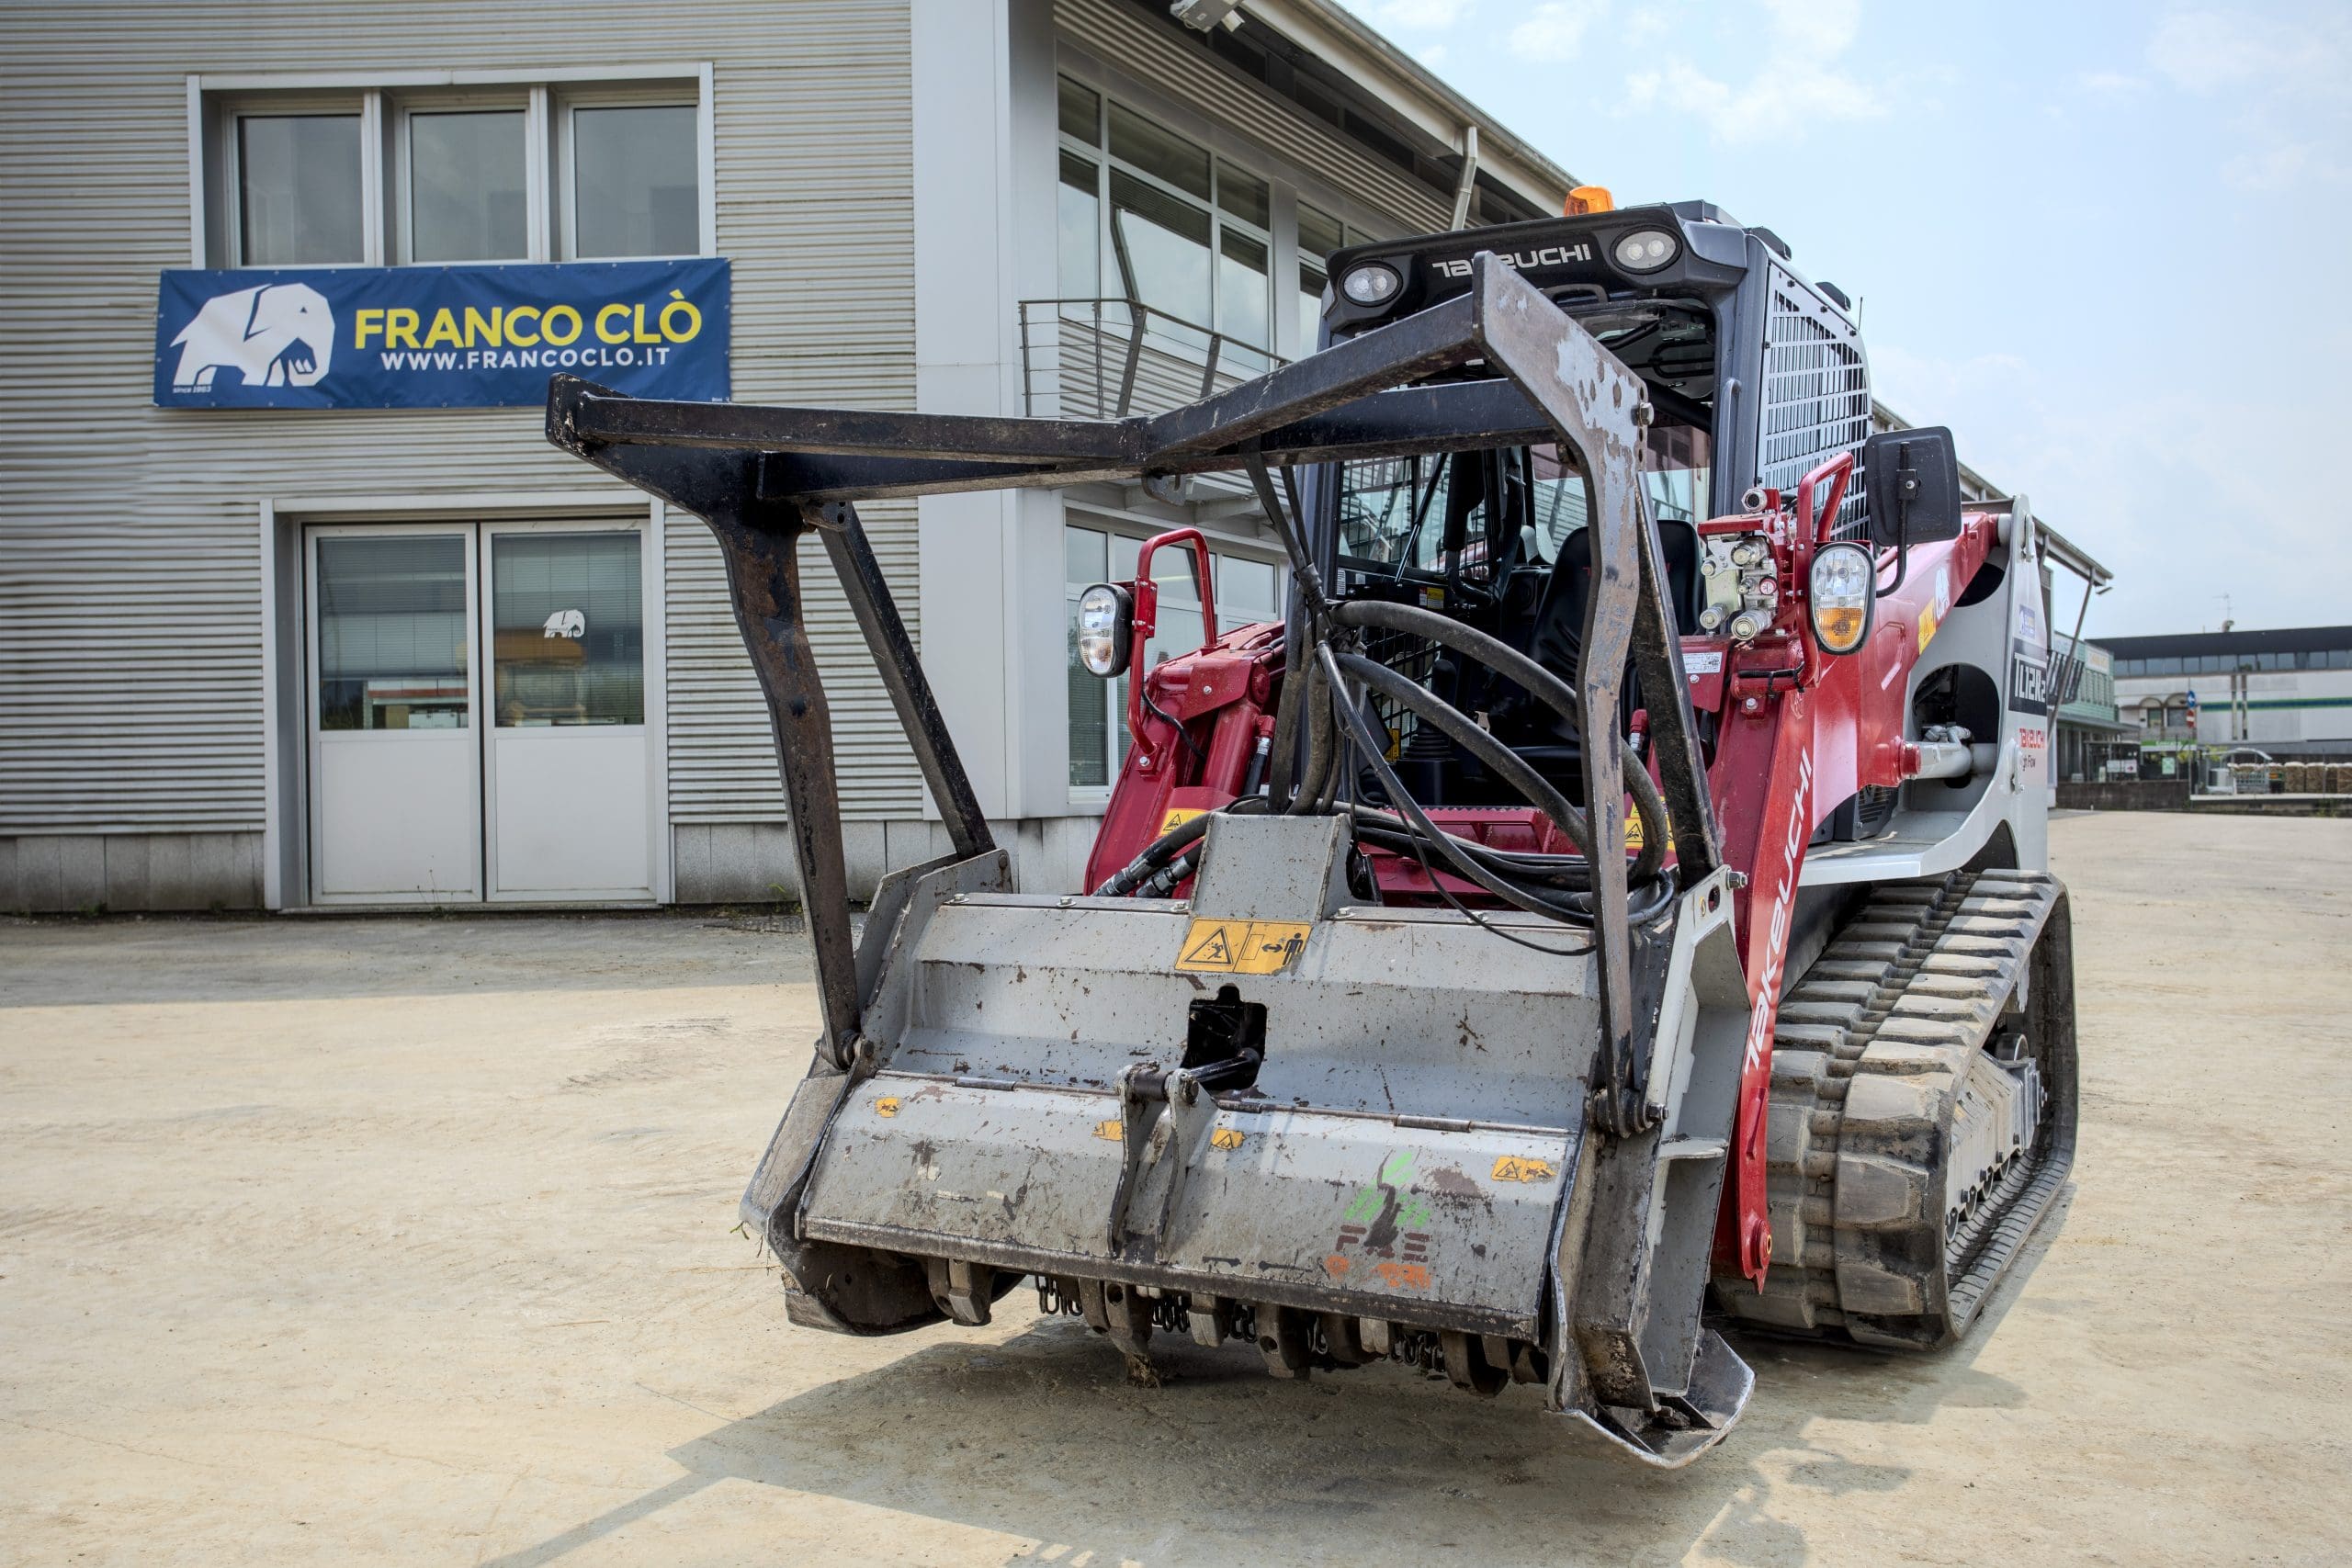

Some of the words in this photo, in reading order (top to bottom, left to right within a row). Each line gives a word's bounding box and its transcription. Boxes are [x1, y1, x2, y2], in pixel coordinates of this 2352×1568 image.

[1431, 243, 1592, 278] TAEUCHI
[355, 304, 583, 349] FRANCO
[594, 288, 703, 345] CLÒ
[380, 346, 671, 370] WWW.FRANCOCLO.IT
[1744, 745, 1813, 1076] TAKEUCHI
